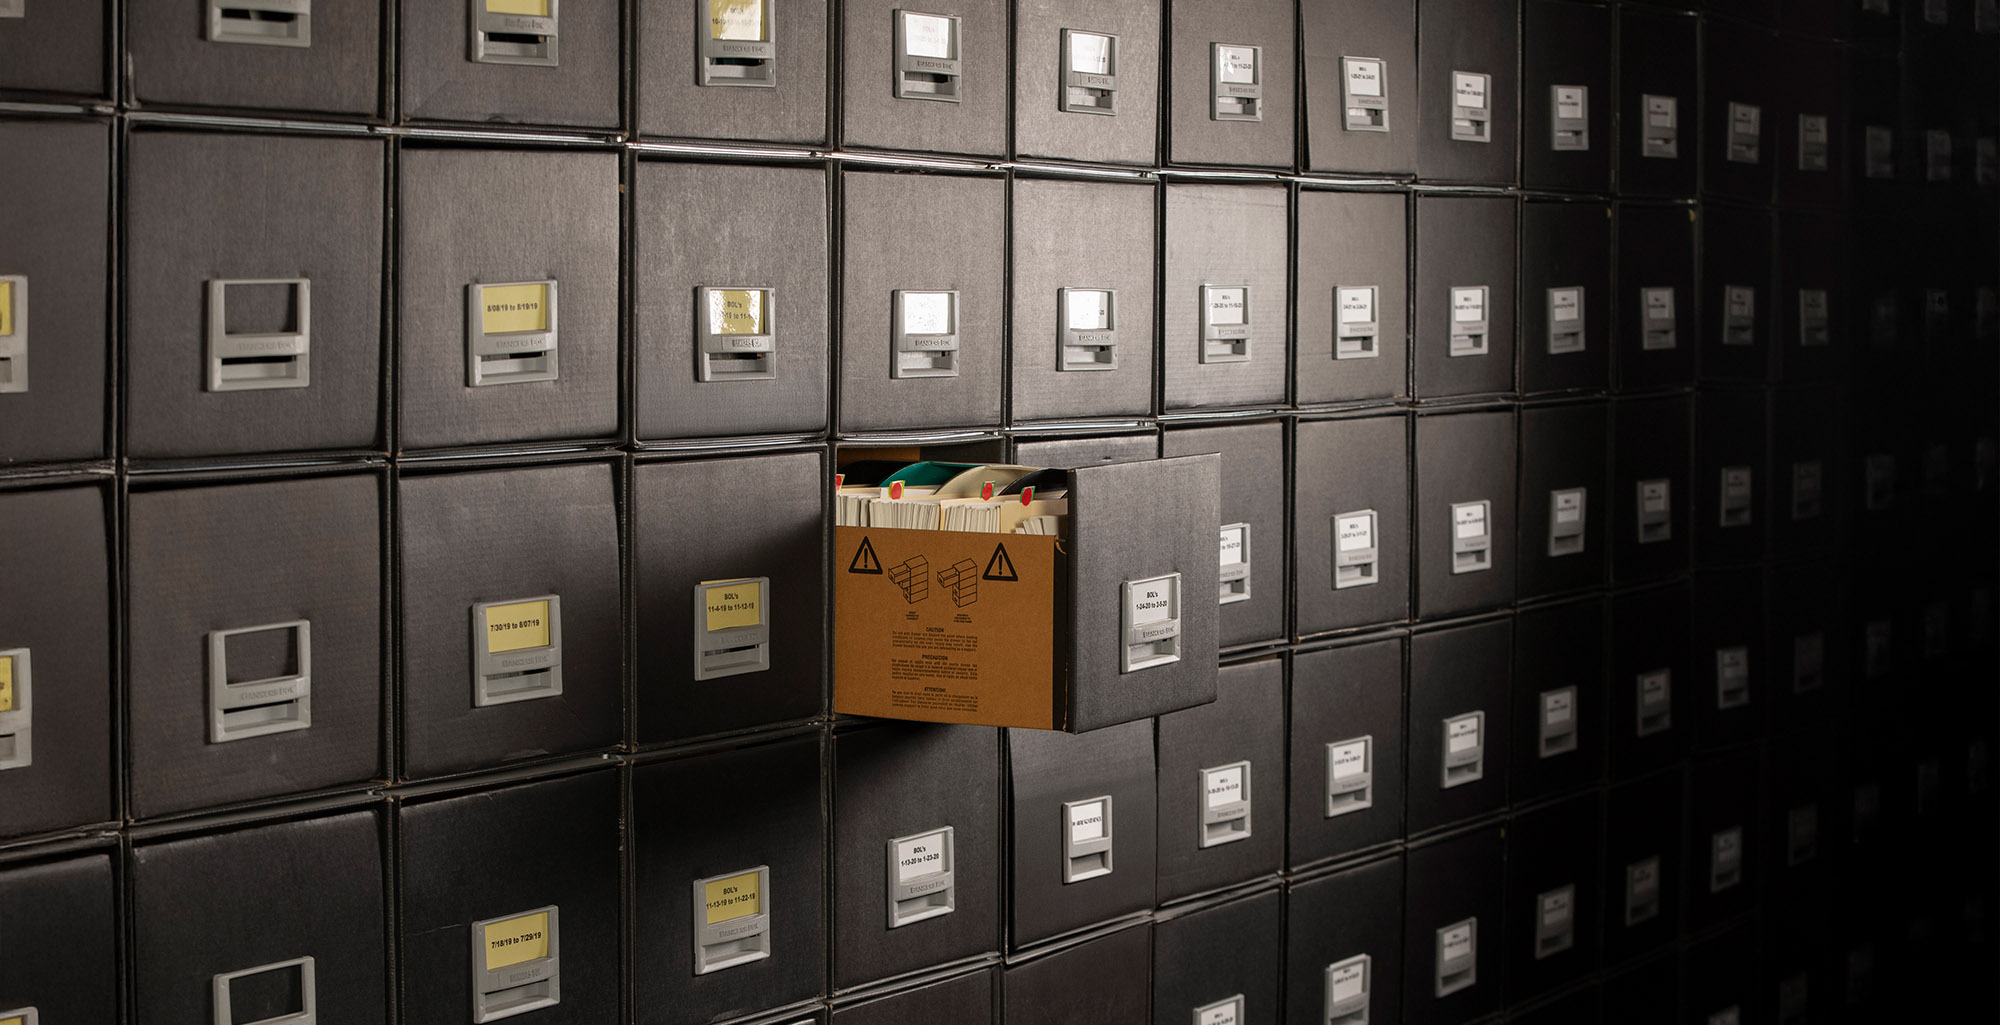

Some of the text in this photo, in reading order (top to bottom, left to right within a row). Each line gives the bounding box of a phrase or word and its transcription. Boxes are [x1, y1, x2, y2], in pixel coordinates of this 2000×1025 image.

[487, 304, 509, 312] 8/08/19
[517, 302, 539, 310] 8/19/19
[724, 592, 739, 600] BOL's
[708, 604, 727, 612] 11-4-19
[734, 602, 754, 610] 11-12-19
[490, 623, 510, 632] 7/30/19
[519, 619, 540, 628] 8/07/19
[913, 846, 927, 854] BOL's
[901, 858, 917, 867] 1-13-20
[923, 853, 939, 862] 1-23-20
[723, 887, 738, 895] BOL's
[706, 899, 727, 909] 11-13-19
[734, 893, 756, 903] 11-22-19
[491, 938, 512, 949] 7/18/19
[520, 931, 542, 942] 7/29/19
